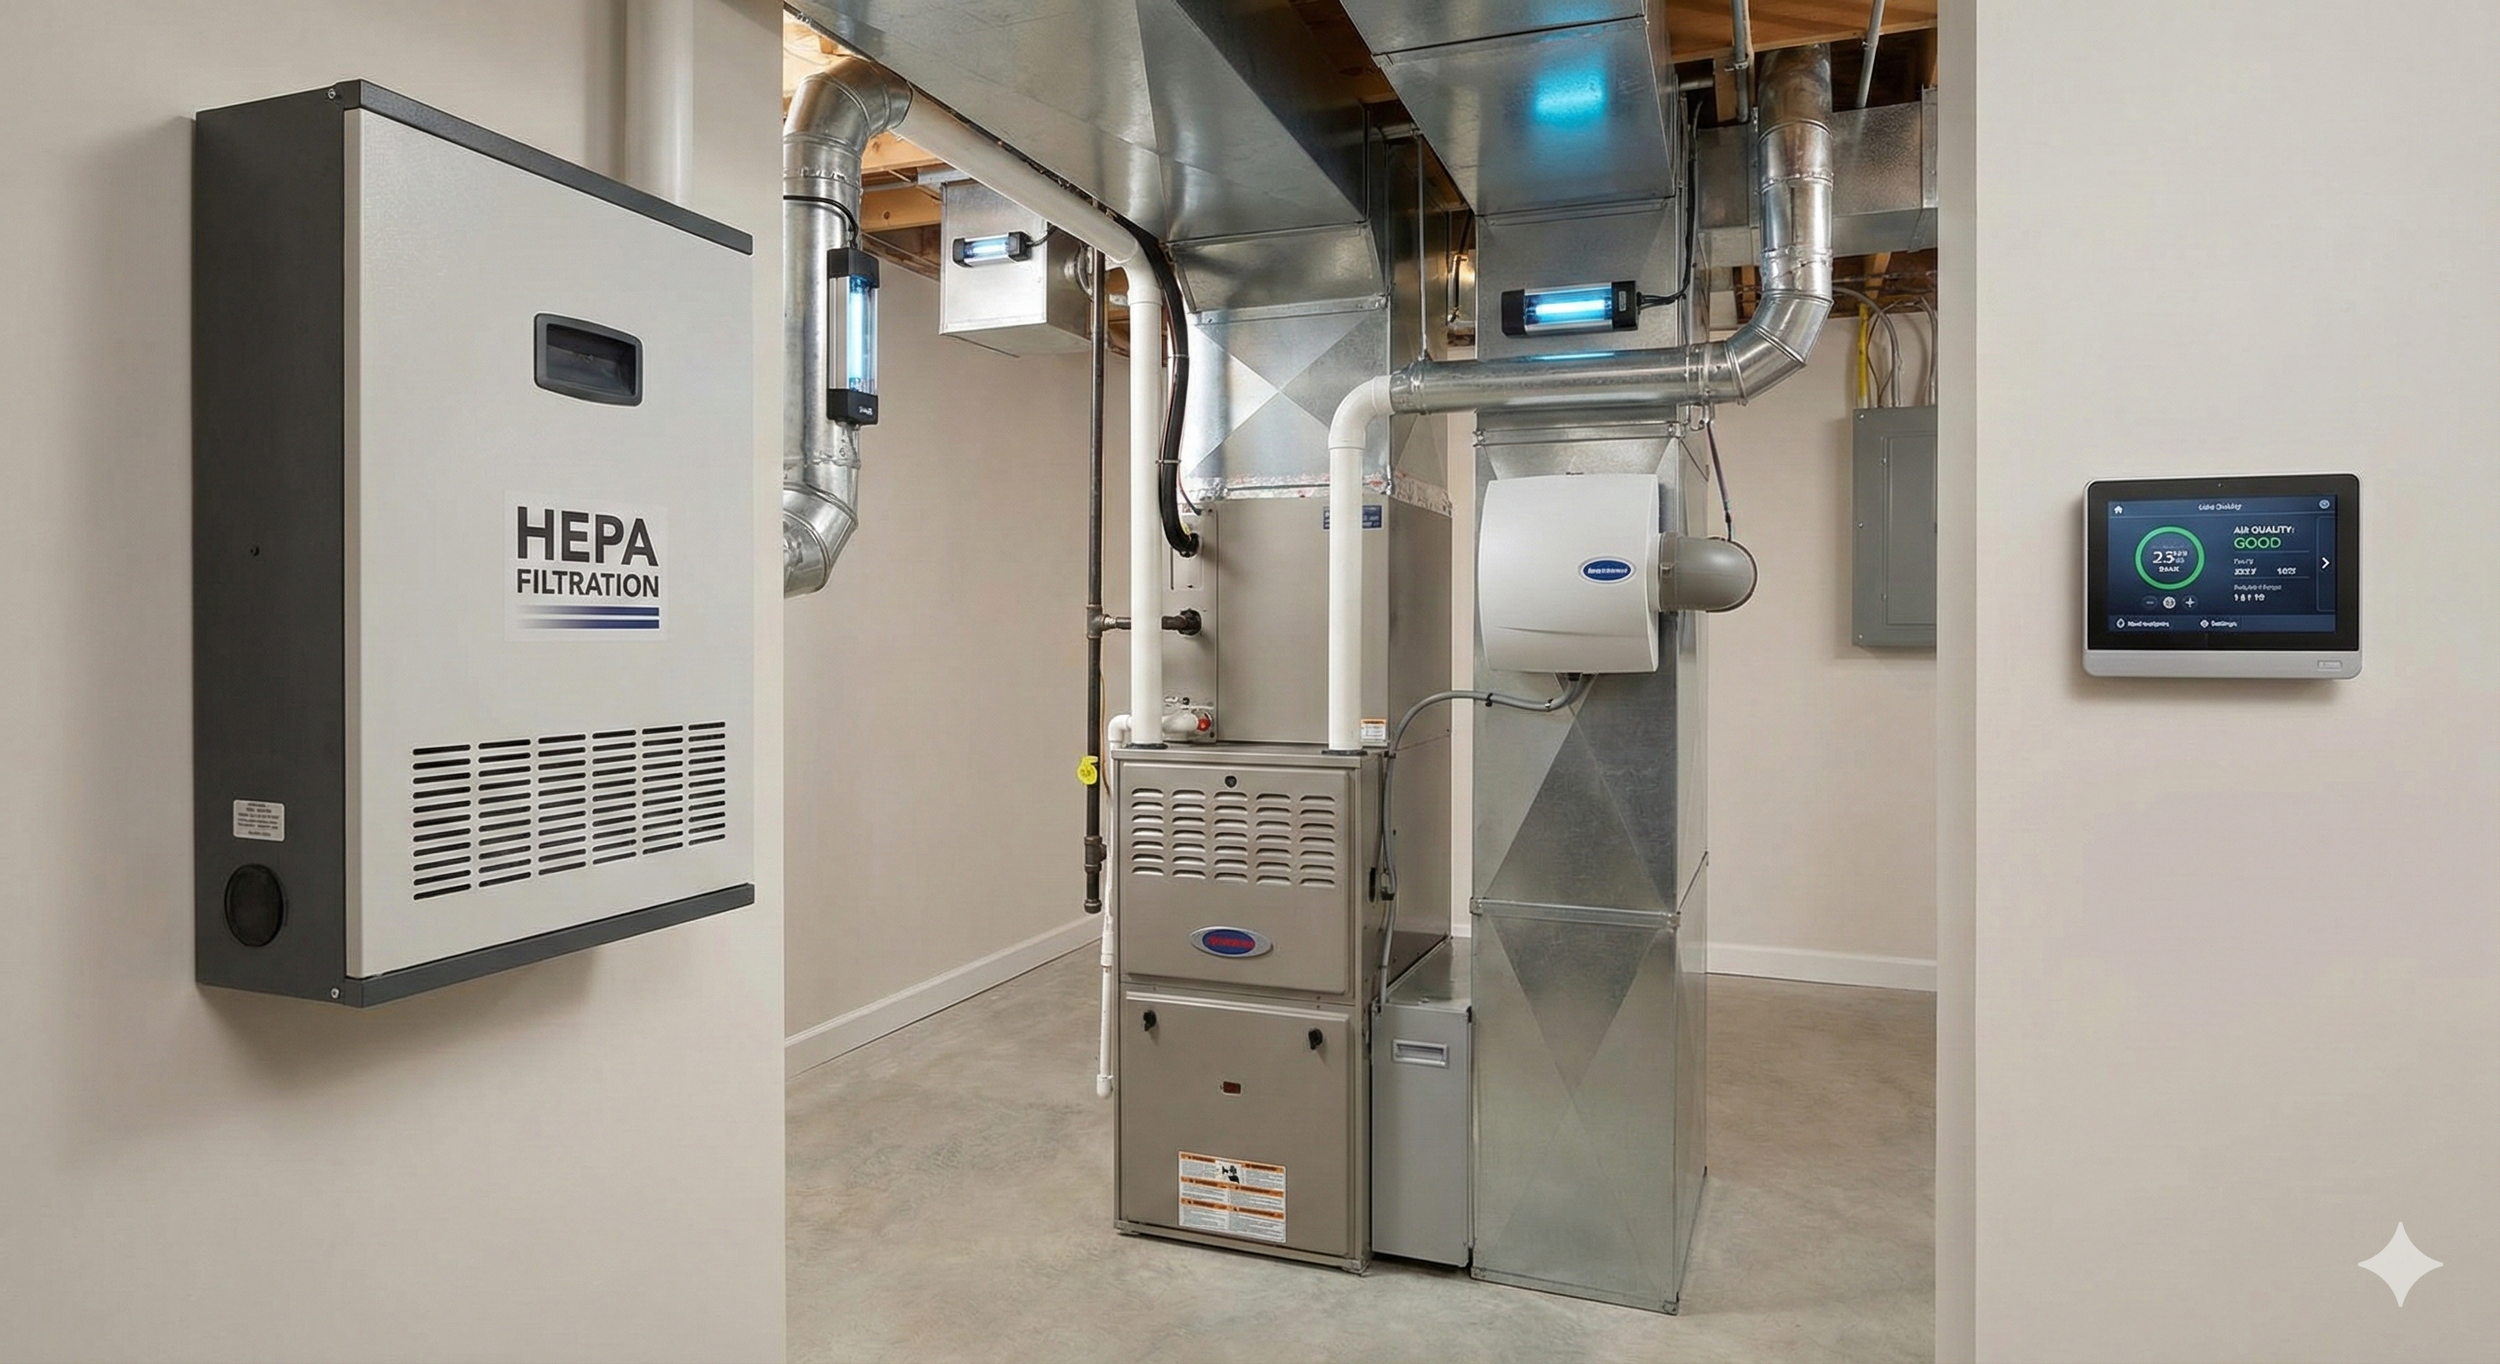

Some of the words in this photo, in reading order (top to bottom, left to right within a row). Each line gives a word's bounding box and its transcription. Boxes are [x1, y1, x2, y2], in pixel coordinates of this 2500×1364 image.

[517, 506, 659, 567] HEPA
[2233, 525, 2250, 534] AIR
[2233, 537, 2282, 549] GOOD
[517, 568, 659, 598] FILTRATION
